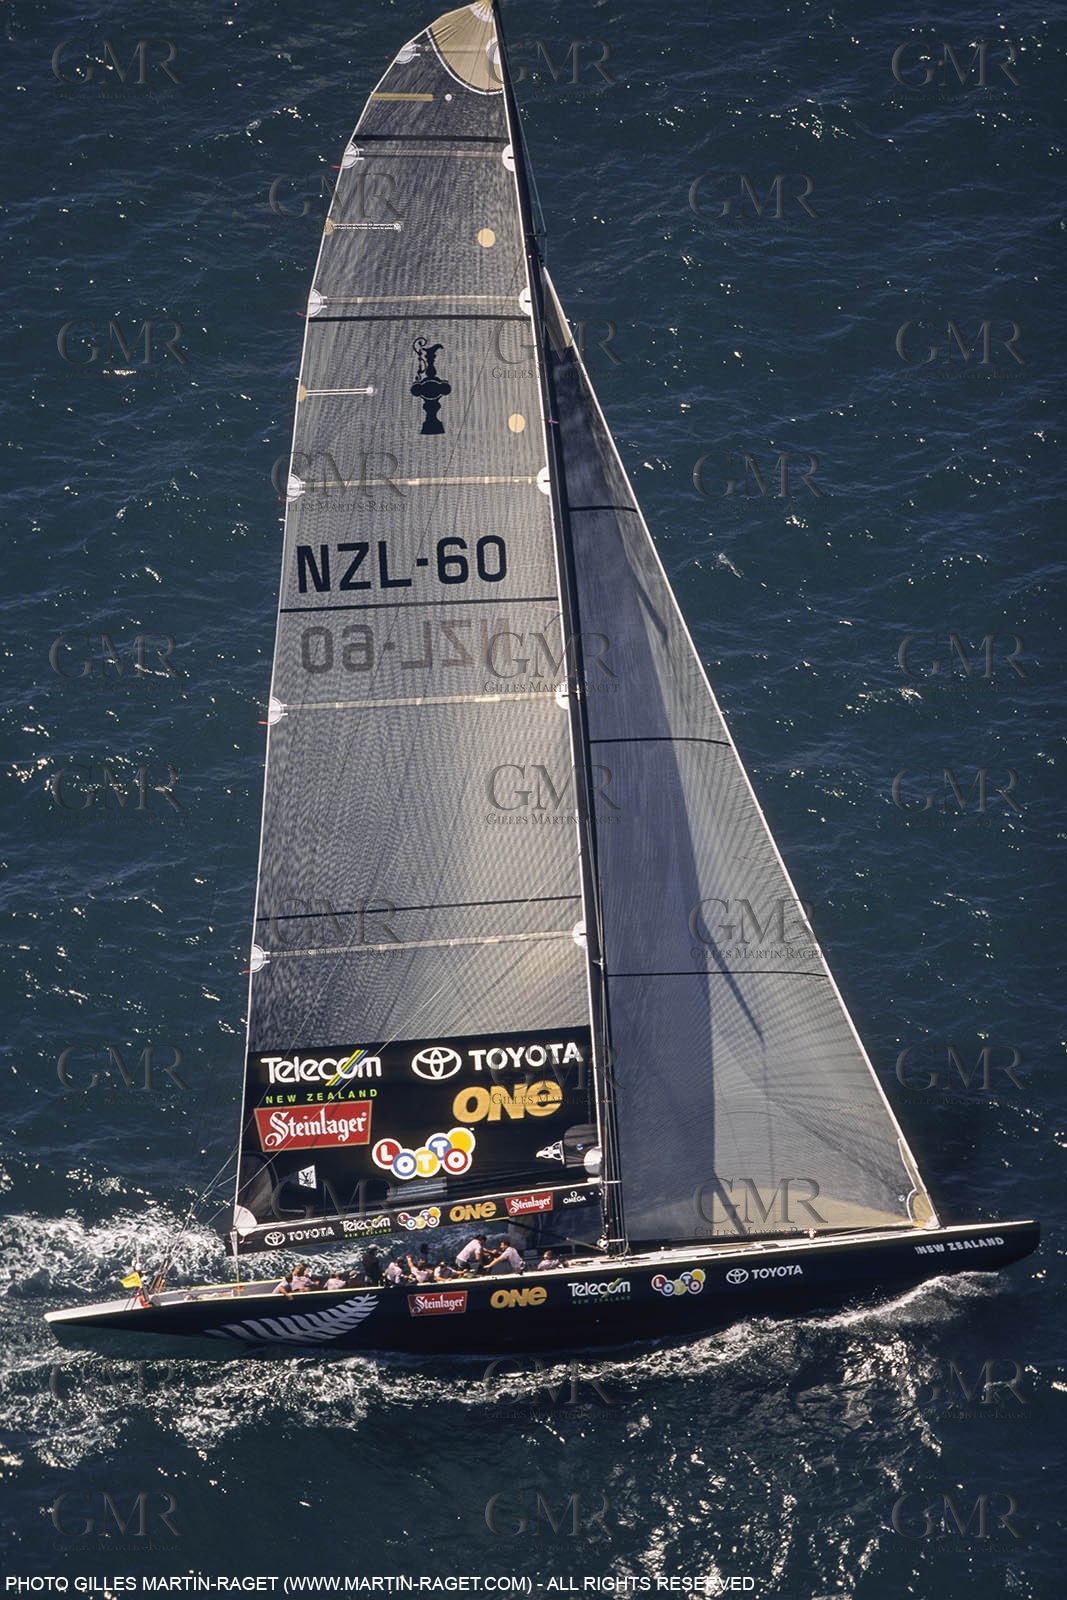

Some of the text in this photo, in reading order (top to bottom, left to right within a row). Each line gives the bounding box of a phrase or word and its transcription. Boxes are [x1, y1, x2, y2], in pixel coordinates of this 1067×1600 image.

[296, 535, 507, 594] NZL-60
[468, 1042, 584, 1071] TOYOTA
[260, 1055, 382, 1084] Telecom
[265, 1088, 378, 1104] NEW ZEALAND
[264, 1106, 368, 1147] Steinlager
[374, 1134, 471, 1177] LOTTO
[509, 1195, 551, 1214] Steinlager
[398, 1209, 439, 1229] LOTTO
[287, 1226, 335, 1242] TOYOTA
[914, 1237, 1005, 1255] NEW ZEALAND
[751, 1265, 803, 1280] TOYOTA
[567, 1281, 631, 1297] Telecom
[653, 1271, 704, 1295] LOTTO
[410, 1293, 465, 1314] Steinlager
